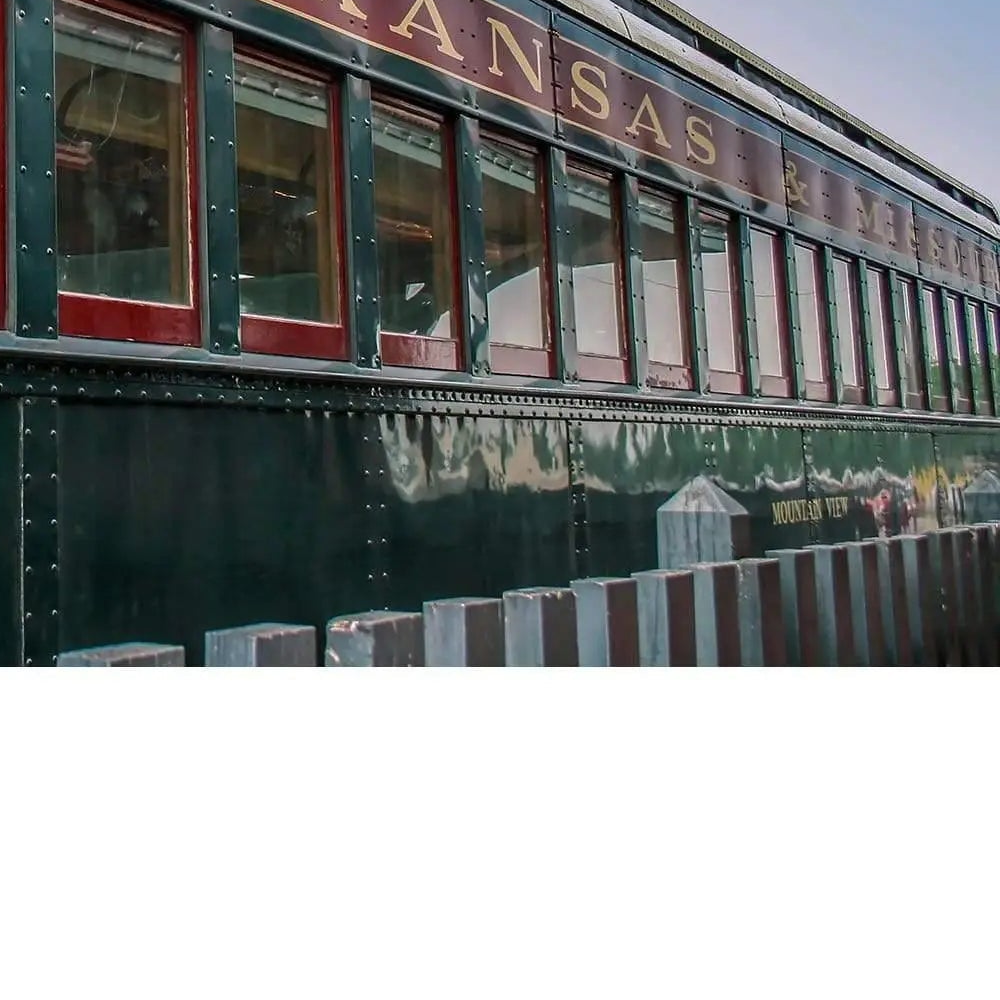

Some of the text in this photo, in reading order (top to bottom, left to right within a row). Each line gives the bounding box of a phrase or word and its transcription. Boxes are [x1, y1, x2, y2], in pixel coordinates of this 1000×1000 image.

[783, 160, 810, 206] &
[772, 496, 849, 525] MOUNTAIN VIEW
